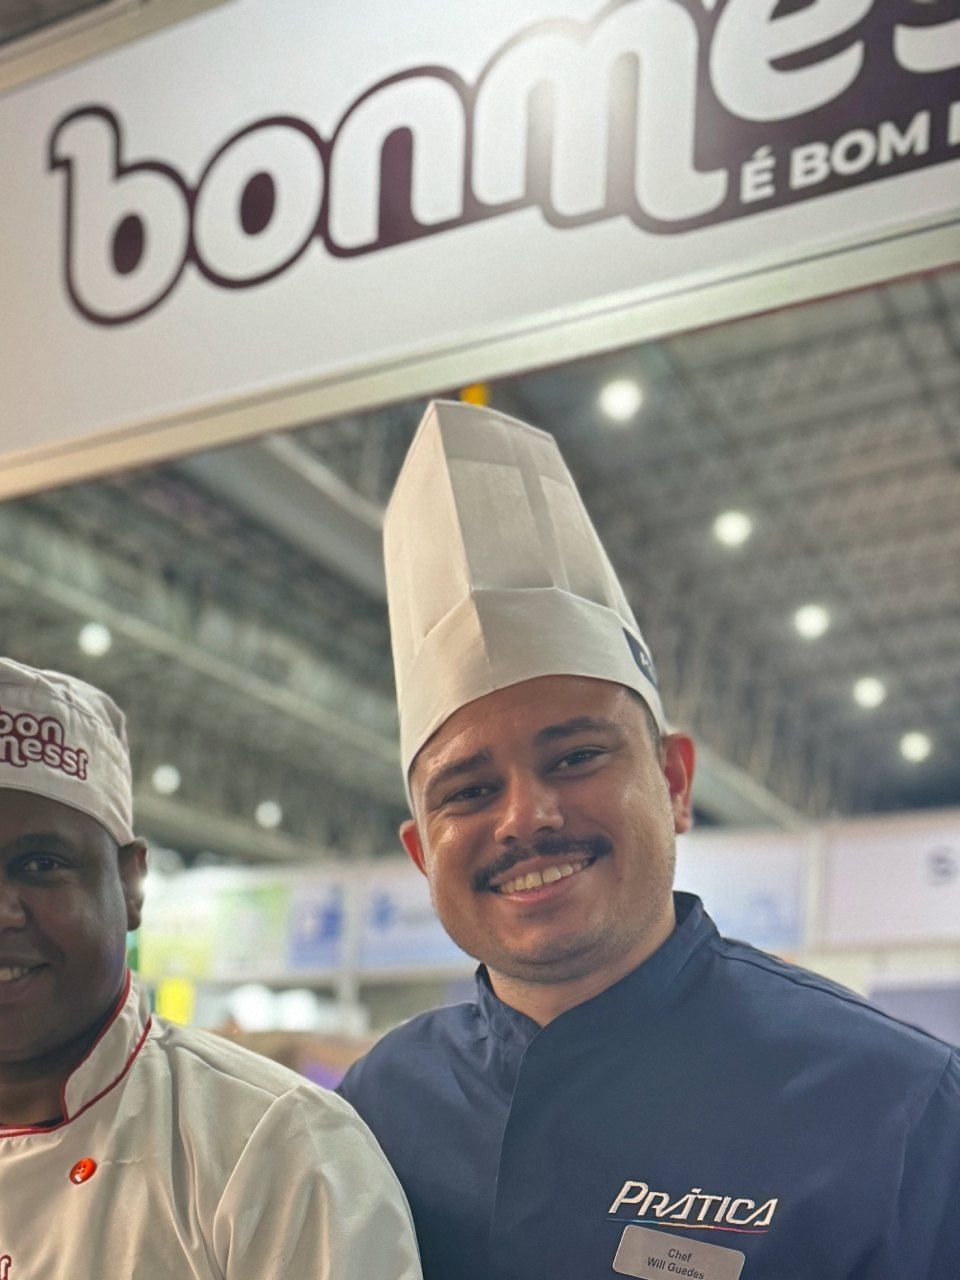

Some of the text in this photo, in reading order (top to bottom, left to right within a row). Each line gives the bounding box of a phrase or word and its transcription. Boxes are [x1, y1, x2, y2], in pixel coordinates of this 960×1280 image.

[741, 145, 776, 204] É
[790, 110, 930, 190] BOM
[668, 1248, 692, 1261] Chef
[647, 1256, 705, 1280] Will Guedes
